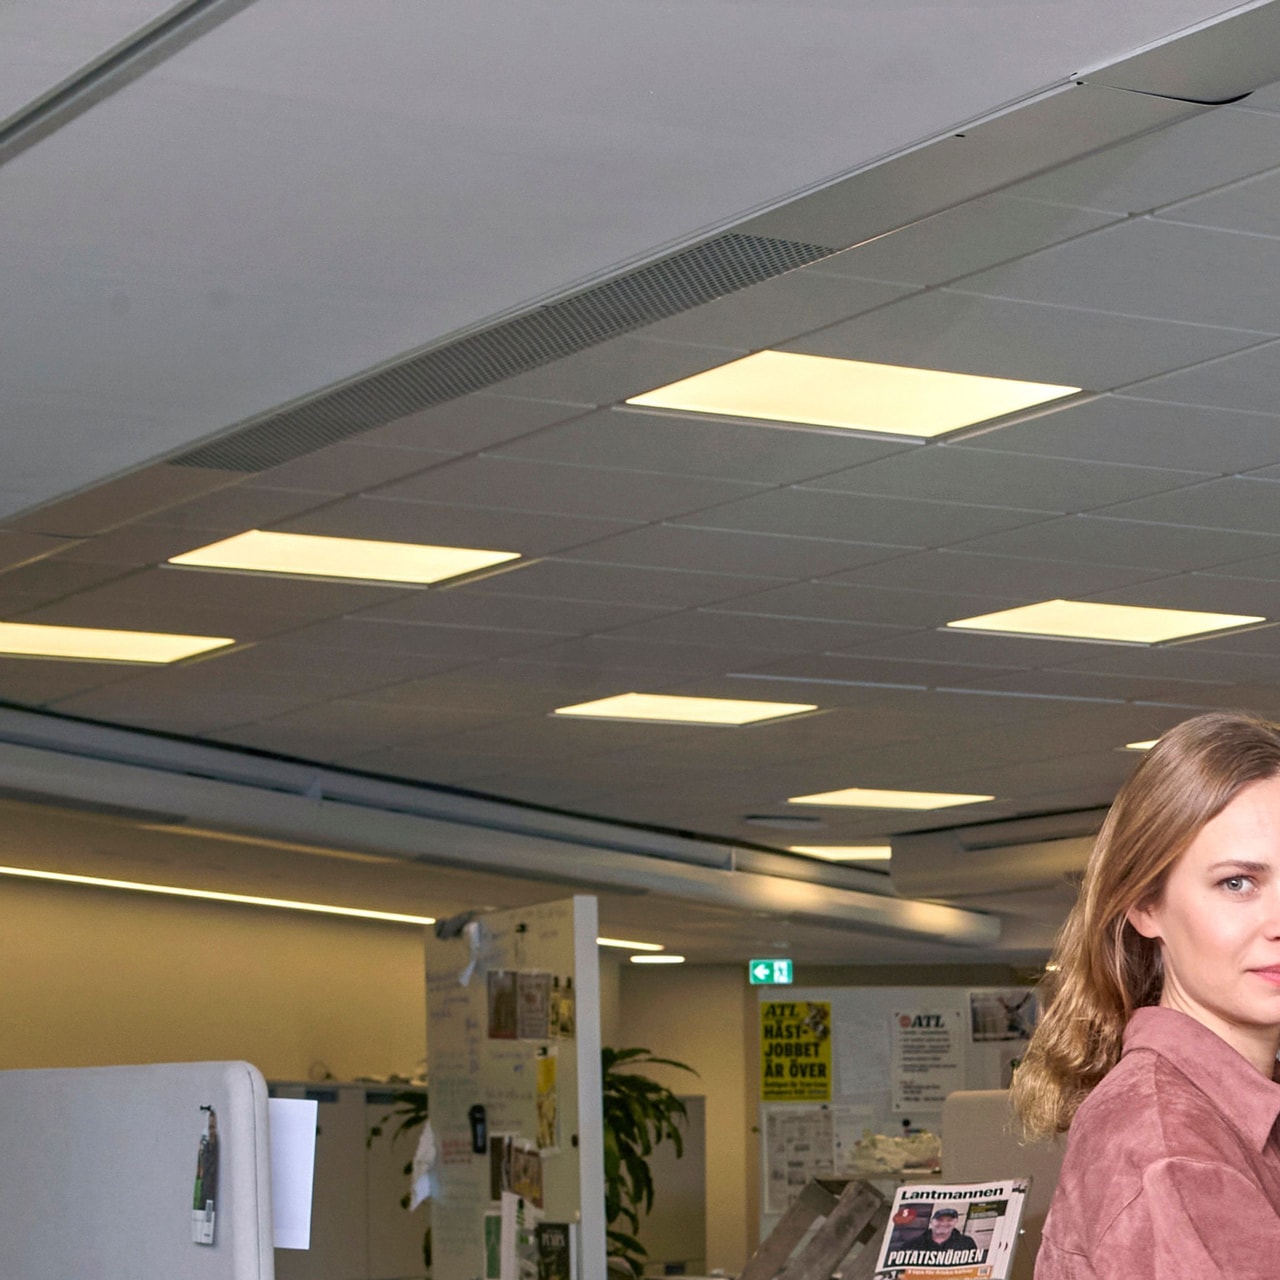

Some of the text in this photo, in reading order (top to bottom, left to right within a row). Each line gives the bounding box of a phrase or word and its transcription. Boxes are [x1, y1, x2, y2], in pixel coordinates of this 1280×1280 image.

[764, 1003, 799, 1018] ATL
[911, 1014, 945, 1029] ATL
[764, 1042, 820, 1057] JOBBET
[789, 1059, 826, 1078] ÖVER
[901, 1187, 1004, 1201] Lantmannen
[888, 1248, 985, 1265] POTATISNÖRDEN
